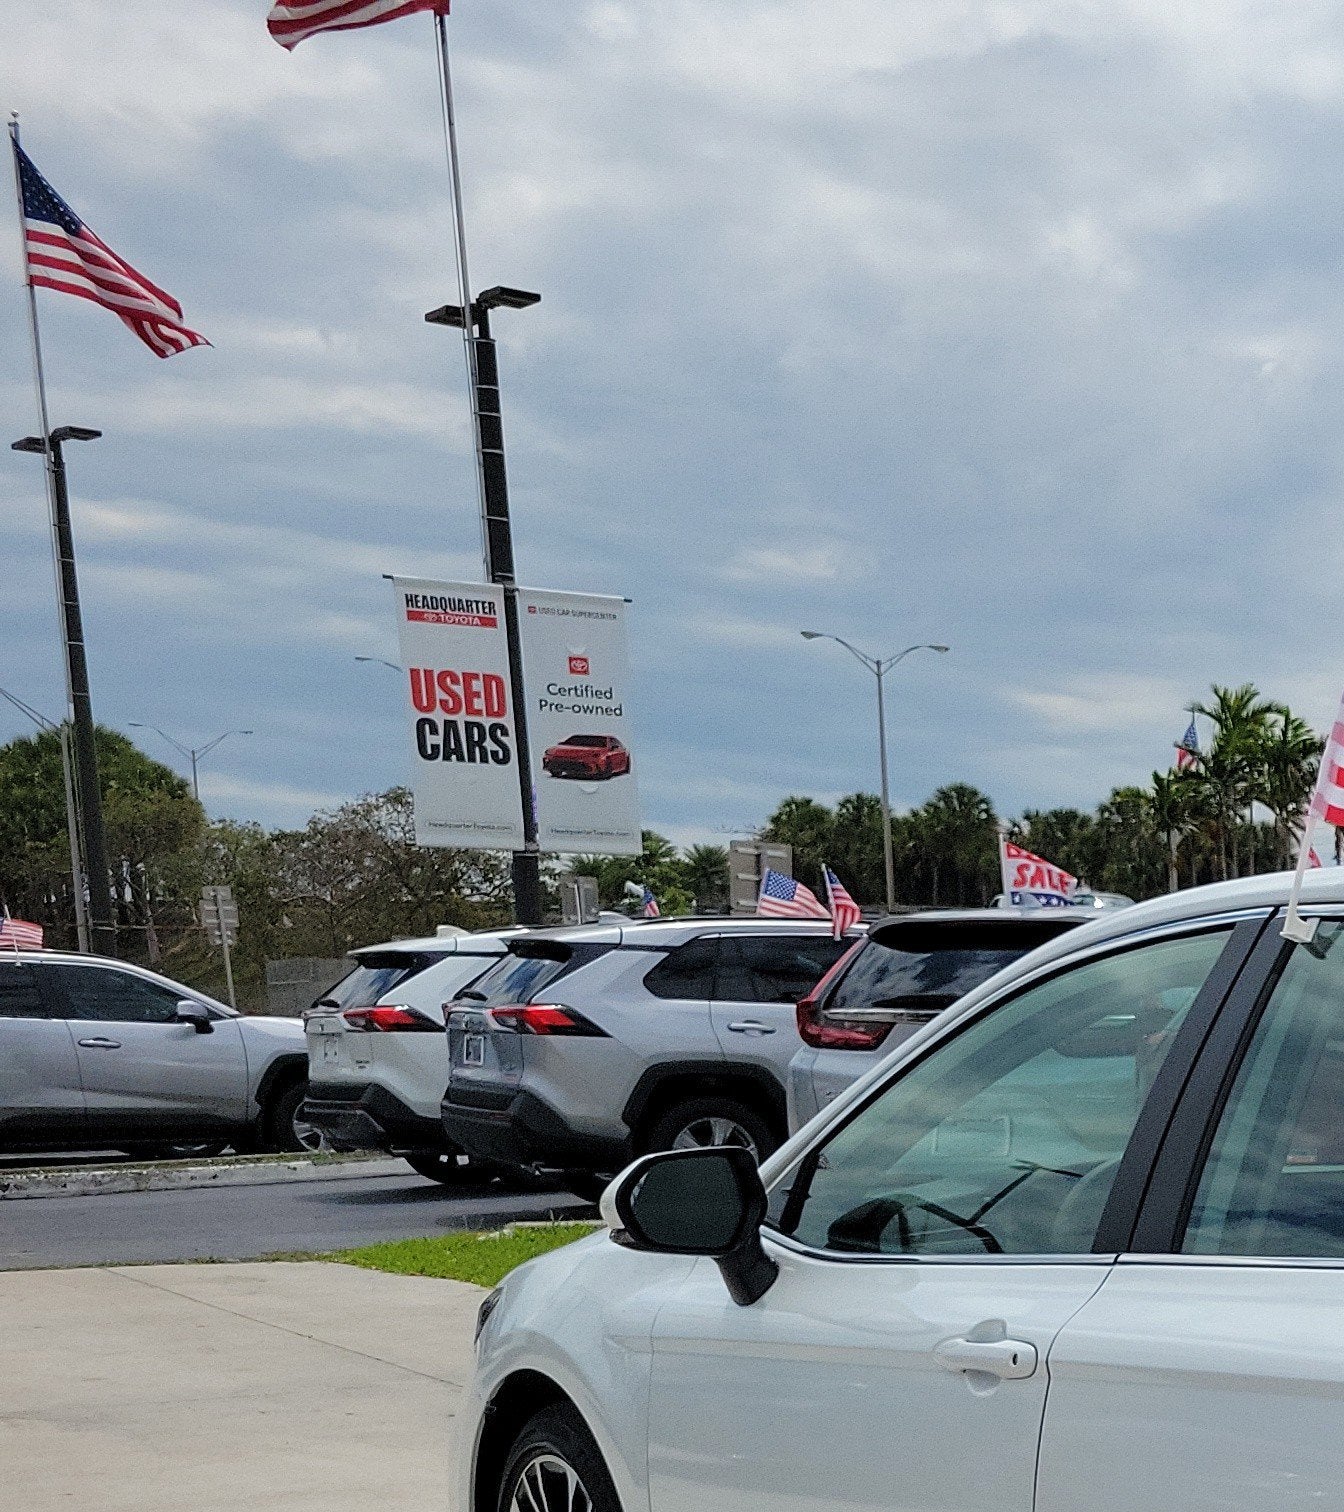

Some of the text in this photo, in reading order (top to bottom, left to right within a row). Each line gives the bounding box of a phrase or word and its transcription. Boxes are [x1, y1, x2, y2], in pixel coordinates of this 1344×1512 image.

[404, 593, 496, 616] HEADQUARTER
[441, 614, 482, 626] TOYOTA
[409, 667, 507, 718] USED
[546, 682, 614, 700] Certified
[539, 698, 623, 717] Pre-owned
[415, 717, 511, 765] CARS
